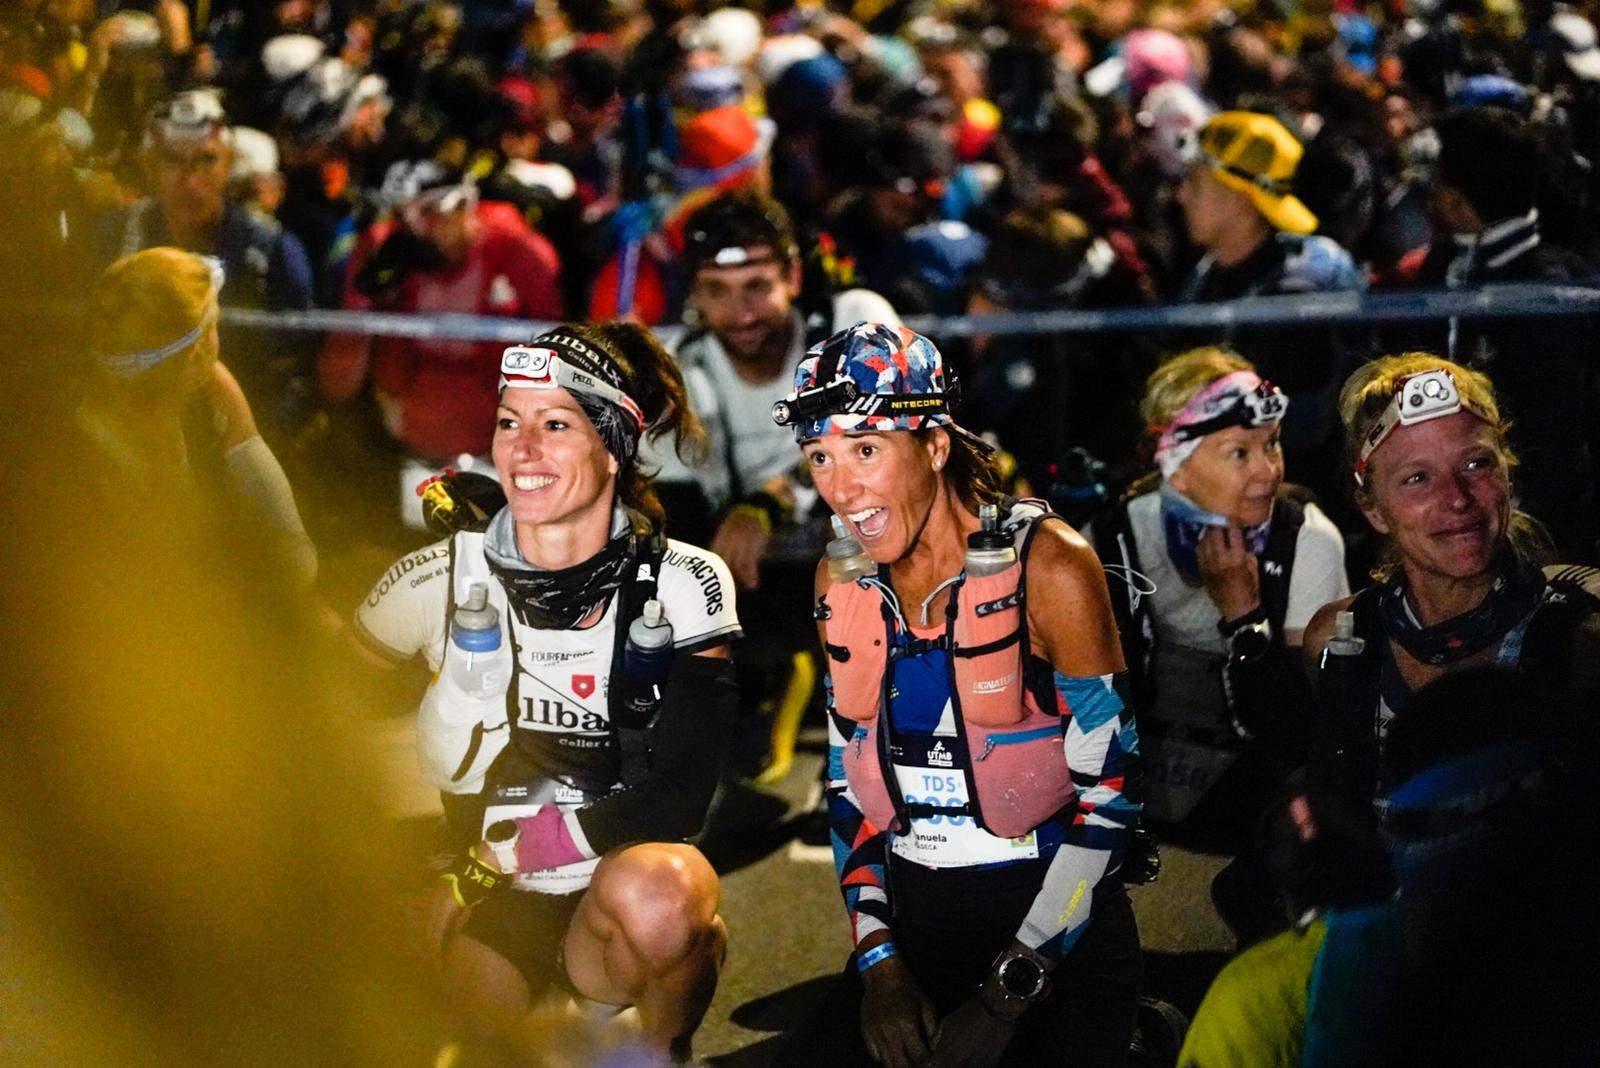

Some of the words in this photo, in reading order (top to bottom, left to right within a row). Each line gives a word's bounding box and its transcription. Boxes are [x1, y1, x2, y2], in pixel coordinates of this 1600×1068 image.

[534, 335, 623, 389] ollbaix
[891, 399, 941, 409] NITECORE
[661, 548, 724, 616] OURFACTORS
[522, 696, 610, 731] llba
[558, 738, 600, 748] Celler
[927, 751, 953, 761] UTMB
[921, 775, 956, 793] TDS
[915, 833, 948, 843] anuela
[464, 864, 498, 889] EKI
